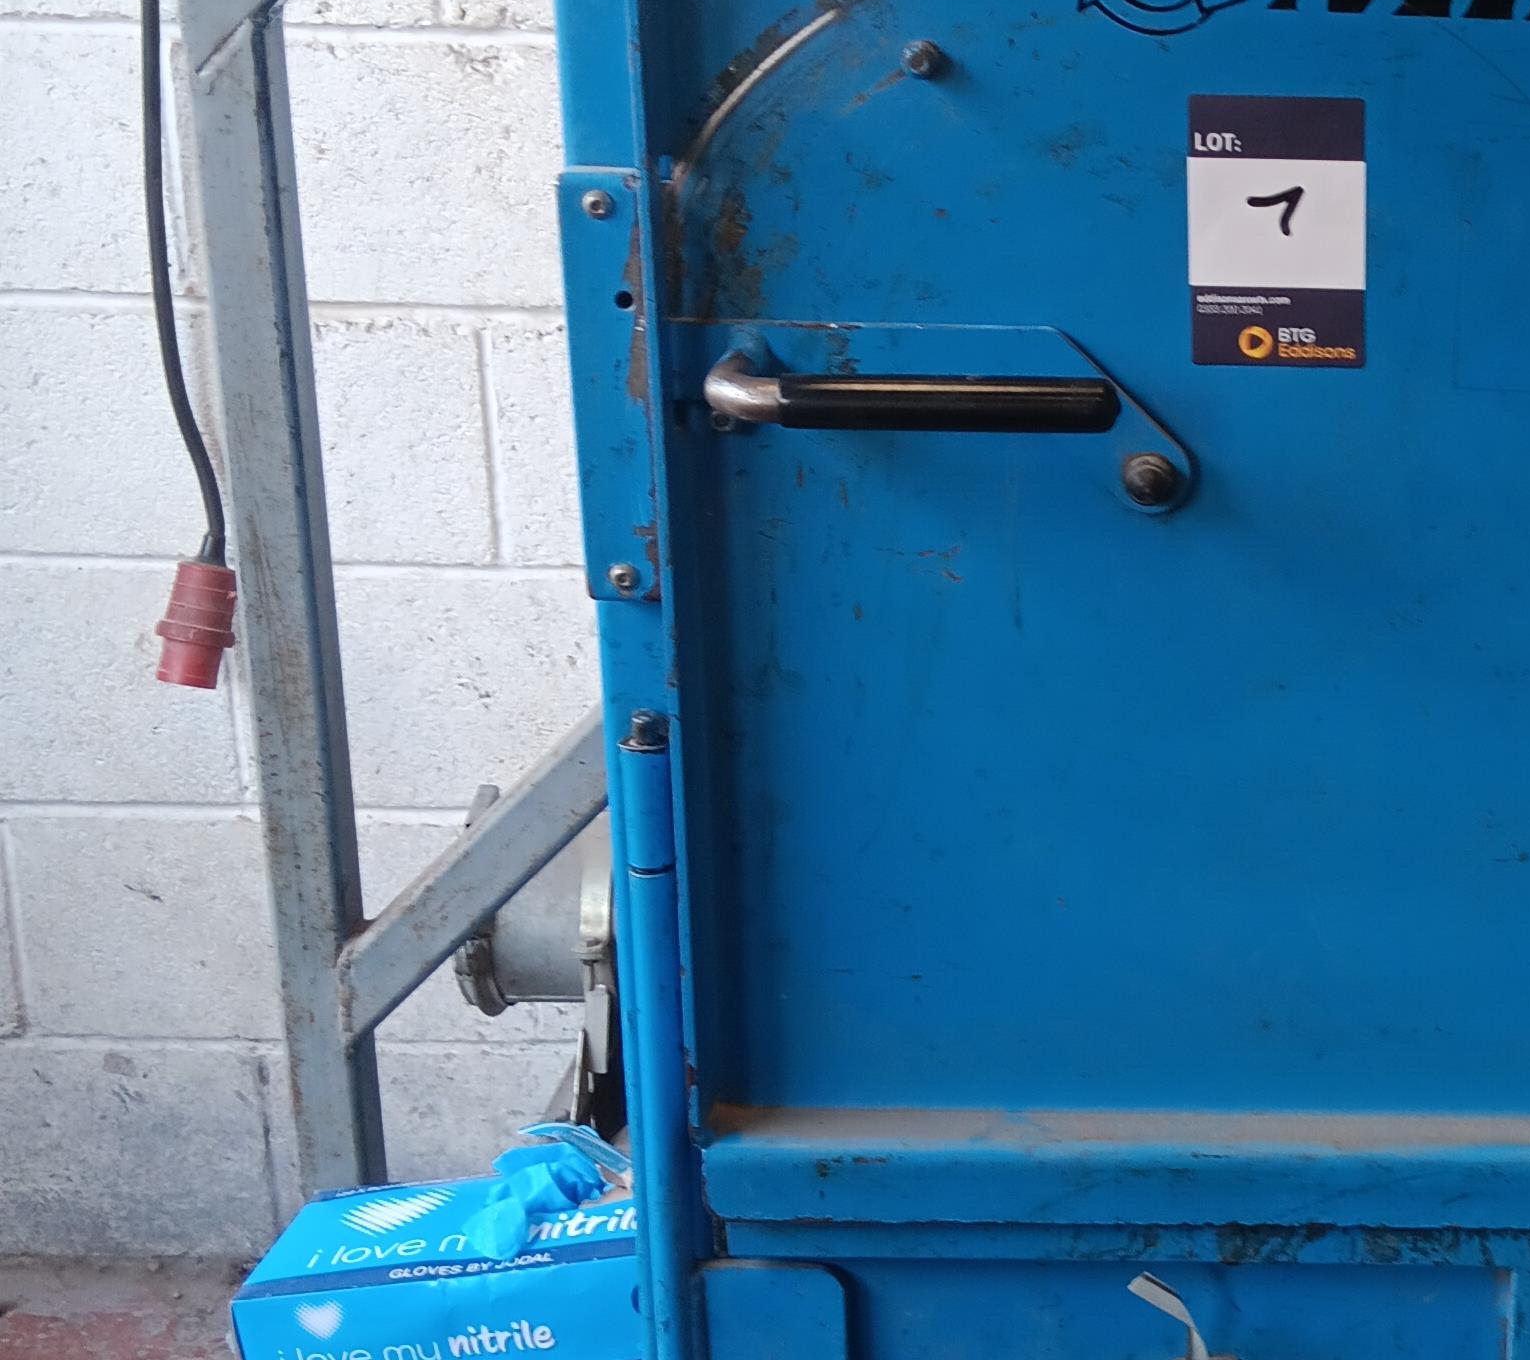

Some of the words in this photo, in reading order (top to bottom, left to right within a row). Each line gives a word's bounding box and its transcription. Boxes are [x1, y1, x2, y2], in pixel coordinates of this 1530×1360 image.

[1193, 131, 1243, 153] LOT:
[1278, 327, 1317, 343] BTG
[1278, 343, 1357, 361] Eddisons
[306, 1248, 324, 1269] i
[331, 1238, 427, 1266] love
[527, 1206, 638, 1243] nitril
[387, 1263, 464, 1280] GLOVES
[466, 1260, 491, 1274] BY
[447, 1319, 557, 1358] nitrile
